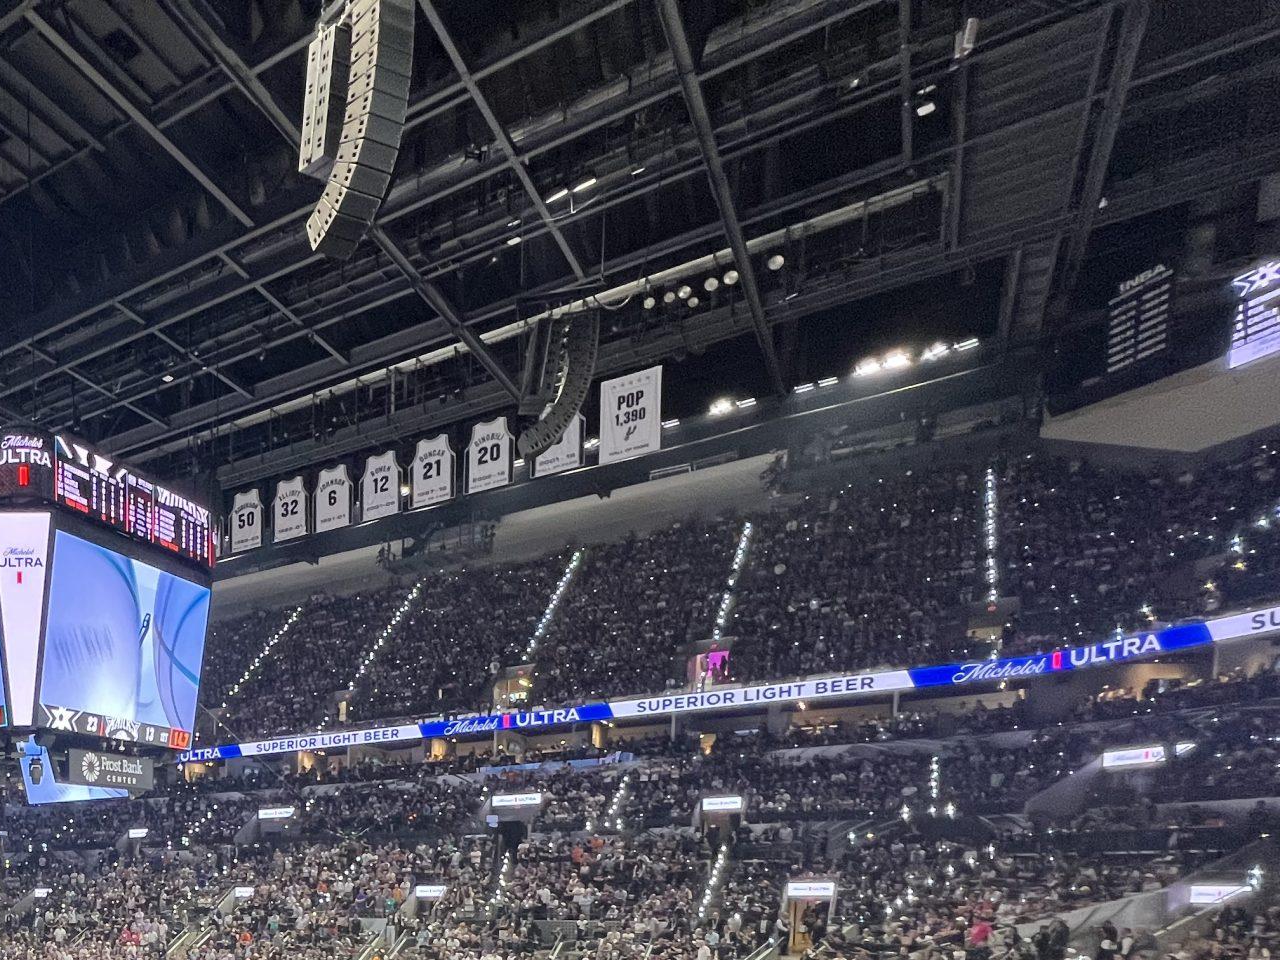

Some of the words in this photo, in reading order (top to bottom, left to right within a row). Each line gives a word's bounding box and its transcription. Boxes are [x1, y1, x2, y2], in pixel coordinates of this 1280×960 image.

[617, 390, 644, 411] POP
[1, 435, 43, 449] Michelob
[477, 443, 501, 466] 20
[422, 459, 442, 480] 21
[373, 475, 389, 494] 12
[328, 490, 337, 506] 6
[281, 499, 299, 518] 32
[238, 511, 255, 529] 50
[952, 657, 1046, 684] Michelob
[1070, 634, 1162, 667] ULTRA
[636, 692, 735, 713] SUPERIOR
[744, 684, 806, 702] LIGHT
[814, 676, 875, 694] BEER
[86, 716, 98, 732] 23
[145, 726, 154, 742] 13
[443, 717, 499, 736] Michelob
[516, 708, 580, 727] ULTRA
[256, 738, 317, 753] SUPERIOR
[321, 733, 359, 746] LIGHT
[364, 728, 400, 741] BEER
[180, 747, 222, 762] ULTRA
[101, 756, 122, 773] Frost
[123, 758, 143, 775] Bank
[106, 774, 137, 785] CENTER
